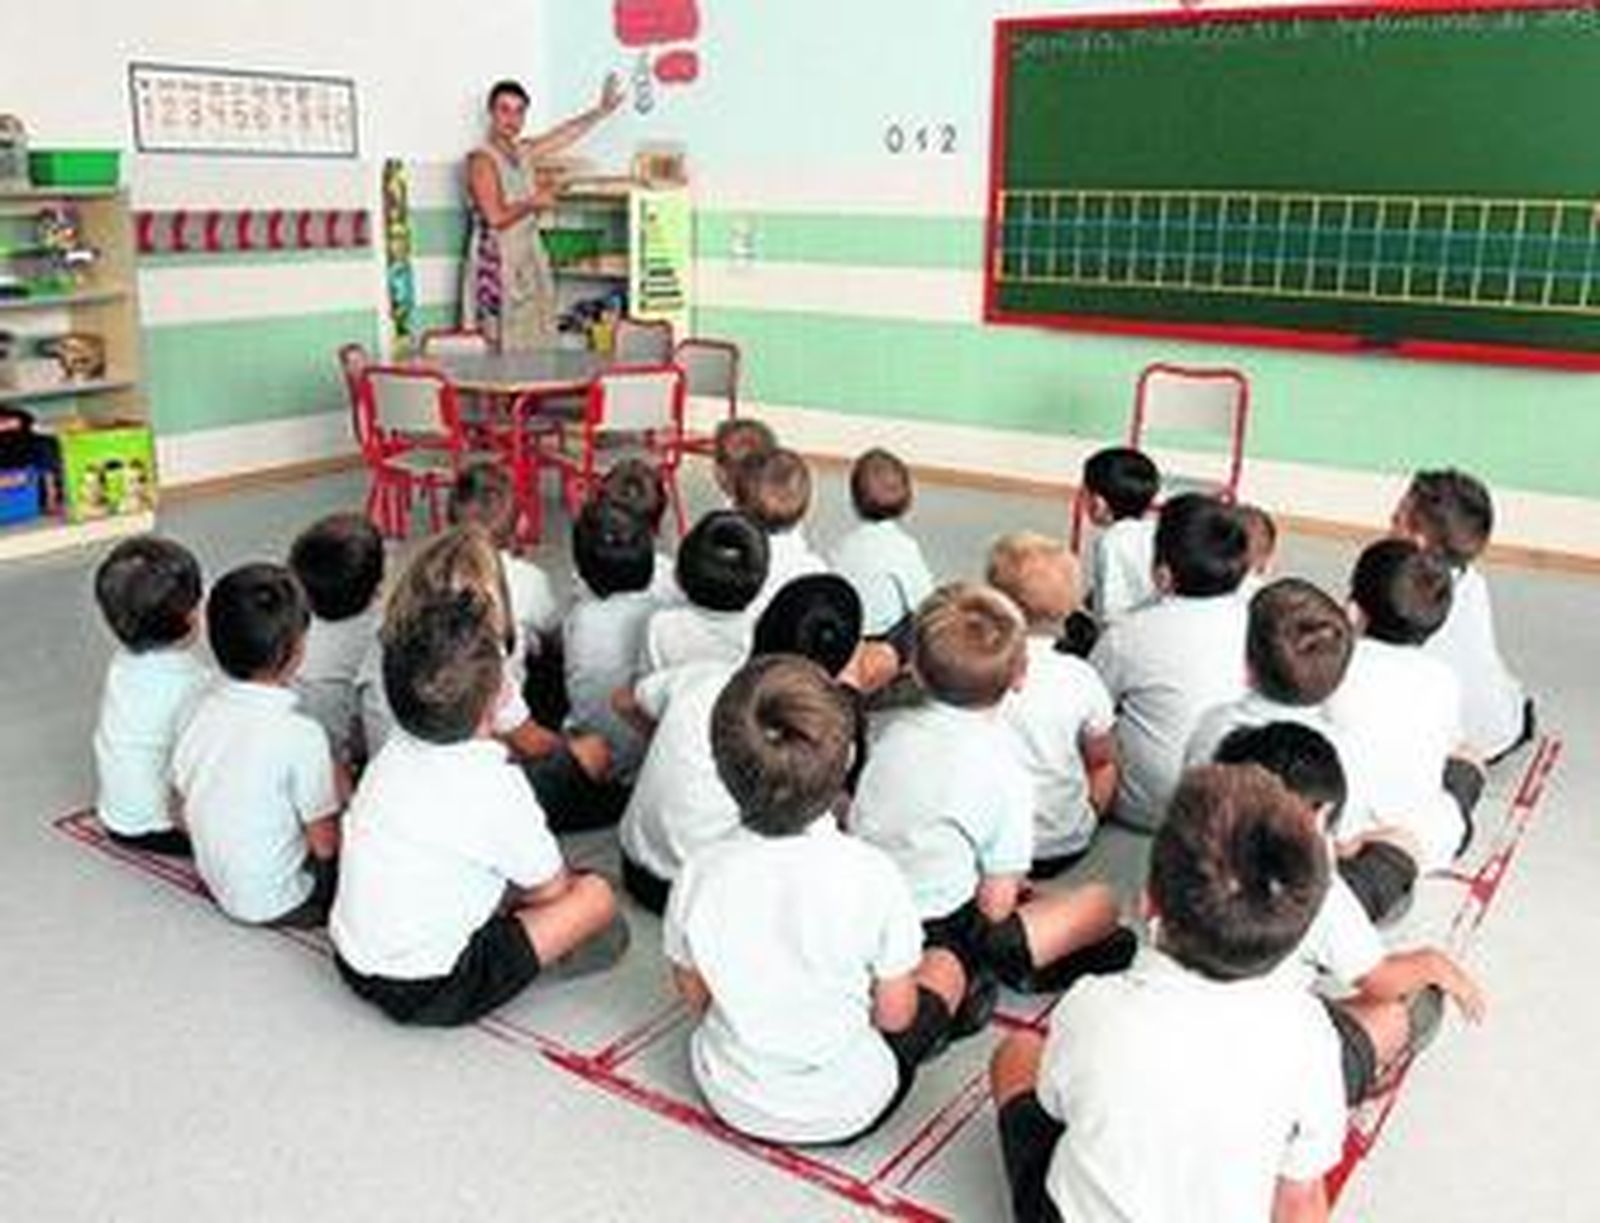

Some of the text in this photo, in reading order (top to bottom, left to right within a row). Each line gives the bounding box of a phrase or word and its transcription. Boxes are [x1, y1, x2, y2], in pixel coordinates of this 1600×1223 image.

[160, 96, 181, 126] 2
[185, 97, 203, 127] 3
[231, 99, 249, 130] 5
[885, 123, 904, 154] 0
[940, 123, 957, 154] 2
